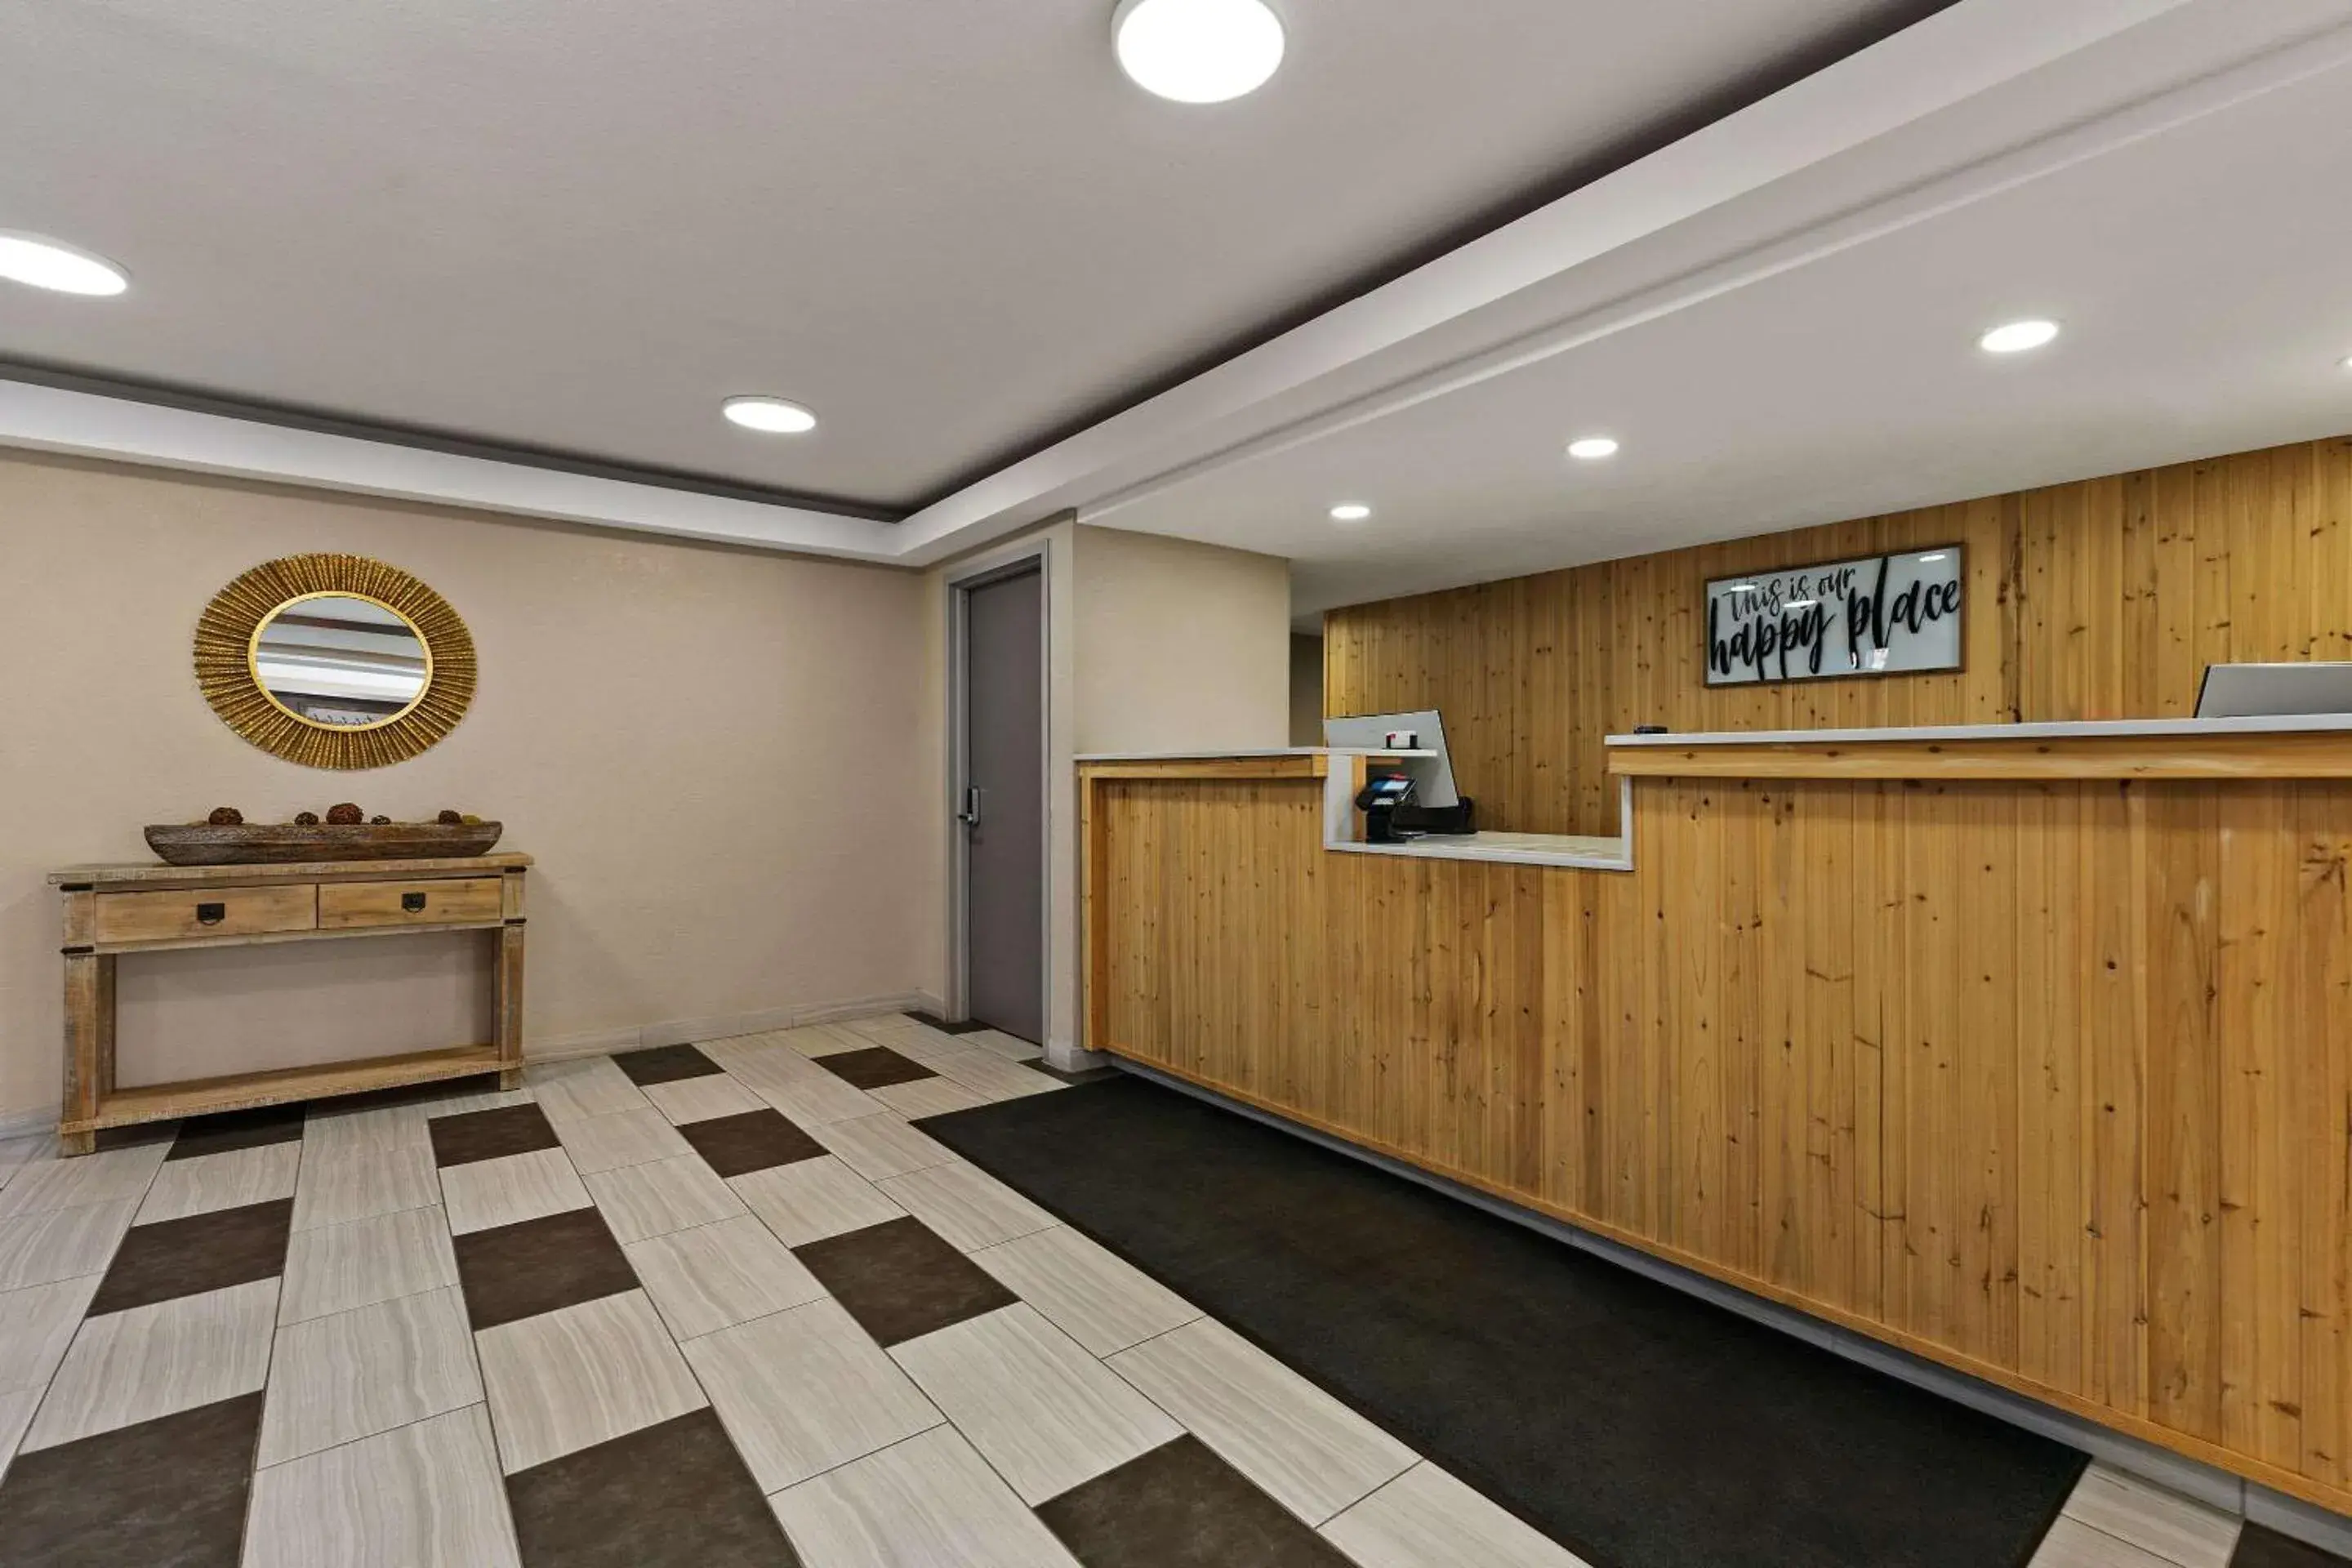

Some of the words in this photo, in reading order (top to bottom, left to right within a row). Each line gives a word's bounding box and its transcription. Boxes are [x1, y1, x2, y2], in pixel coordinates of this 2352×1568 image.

[1710, 597, 1837, 680] happy
[1847, 556, 1960, 670] place
[1722, 576, 1782, 621] this
[1788, 574, 1811, 608] is
[1817, 568, 1855, 601] our
